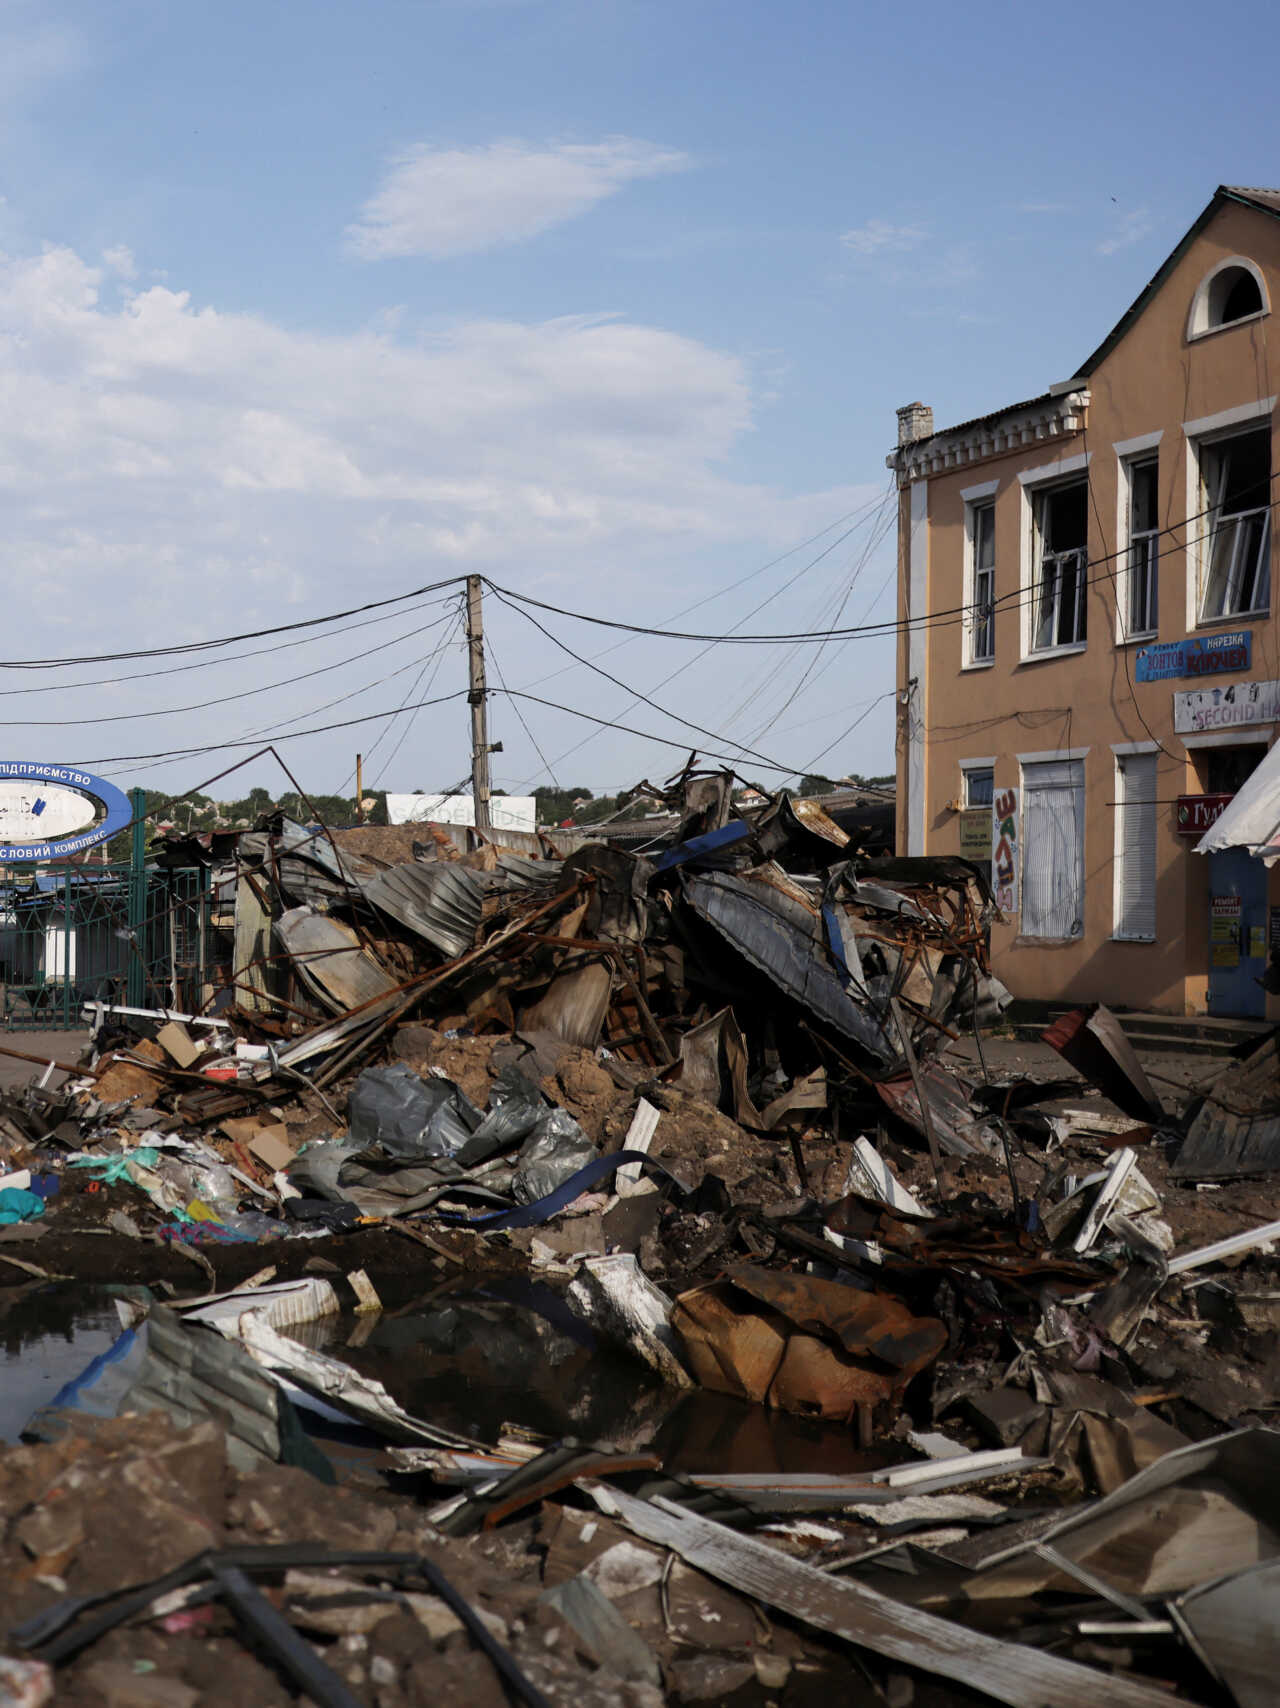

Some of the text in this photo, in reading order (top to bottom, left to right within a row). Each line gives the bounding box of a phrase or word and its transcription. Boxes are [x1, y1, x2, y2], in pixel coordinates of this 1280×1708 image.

[1207, 633, 1244, 649] НАРЕЗКА
[1147, 650, 1184, 670] ЗОНТОВ
[1195, 703, 1255, 727] SECOND
[54, 831, 107, 854] КОМПЛЕКС
